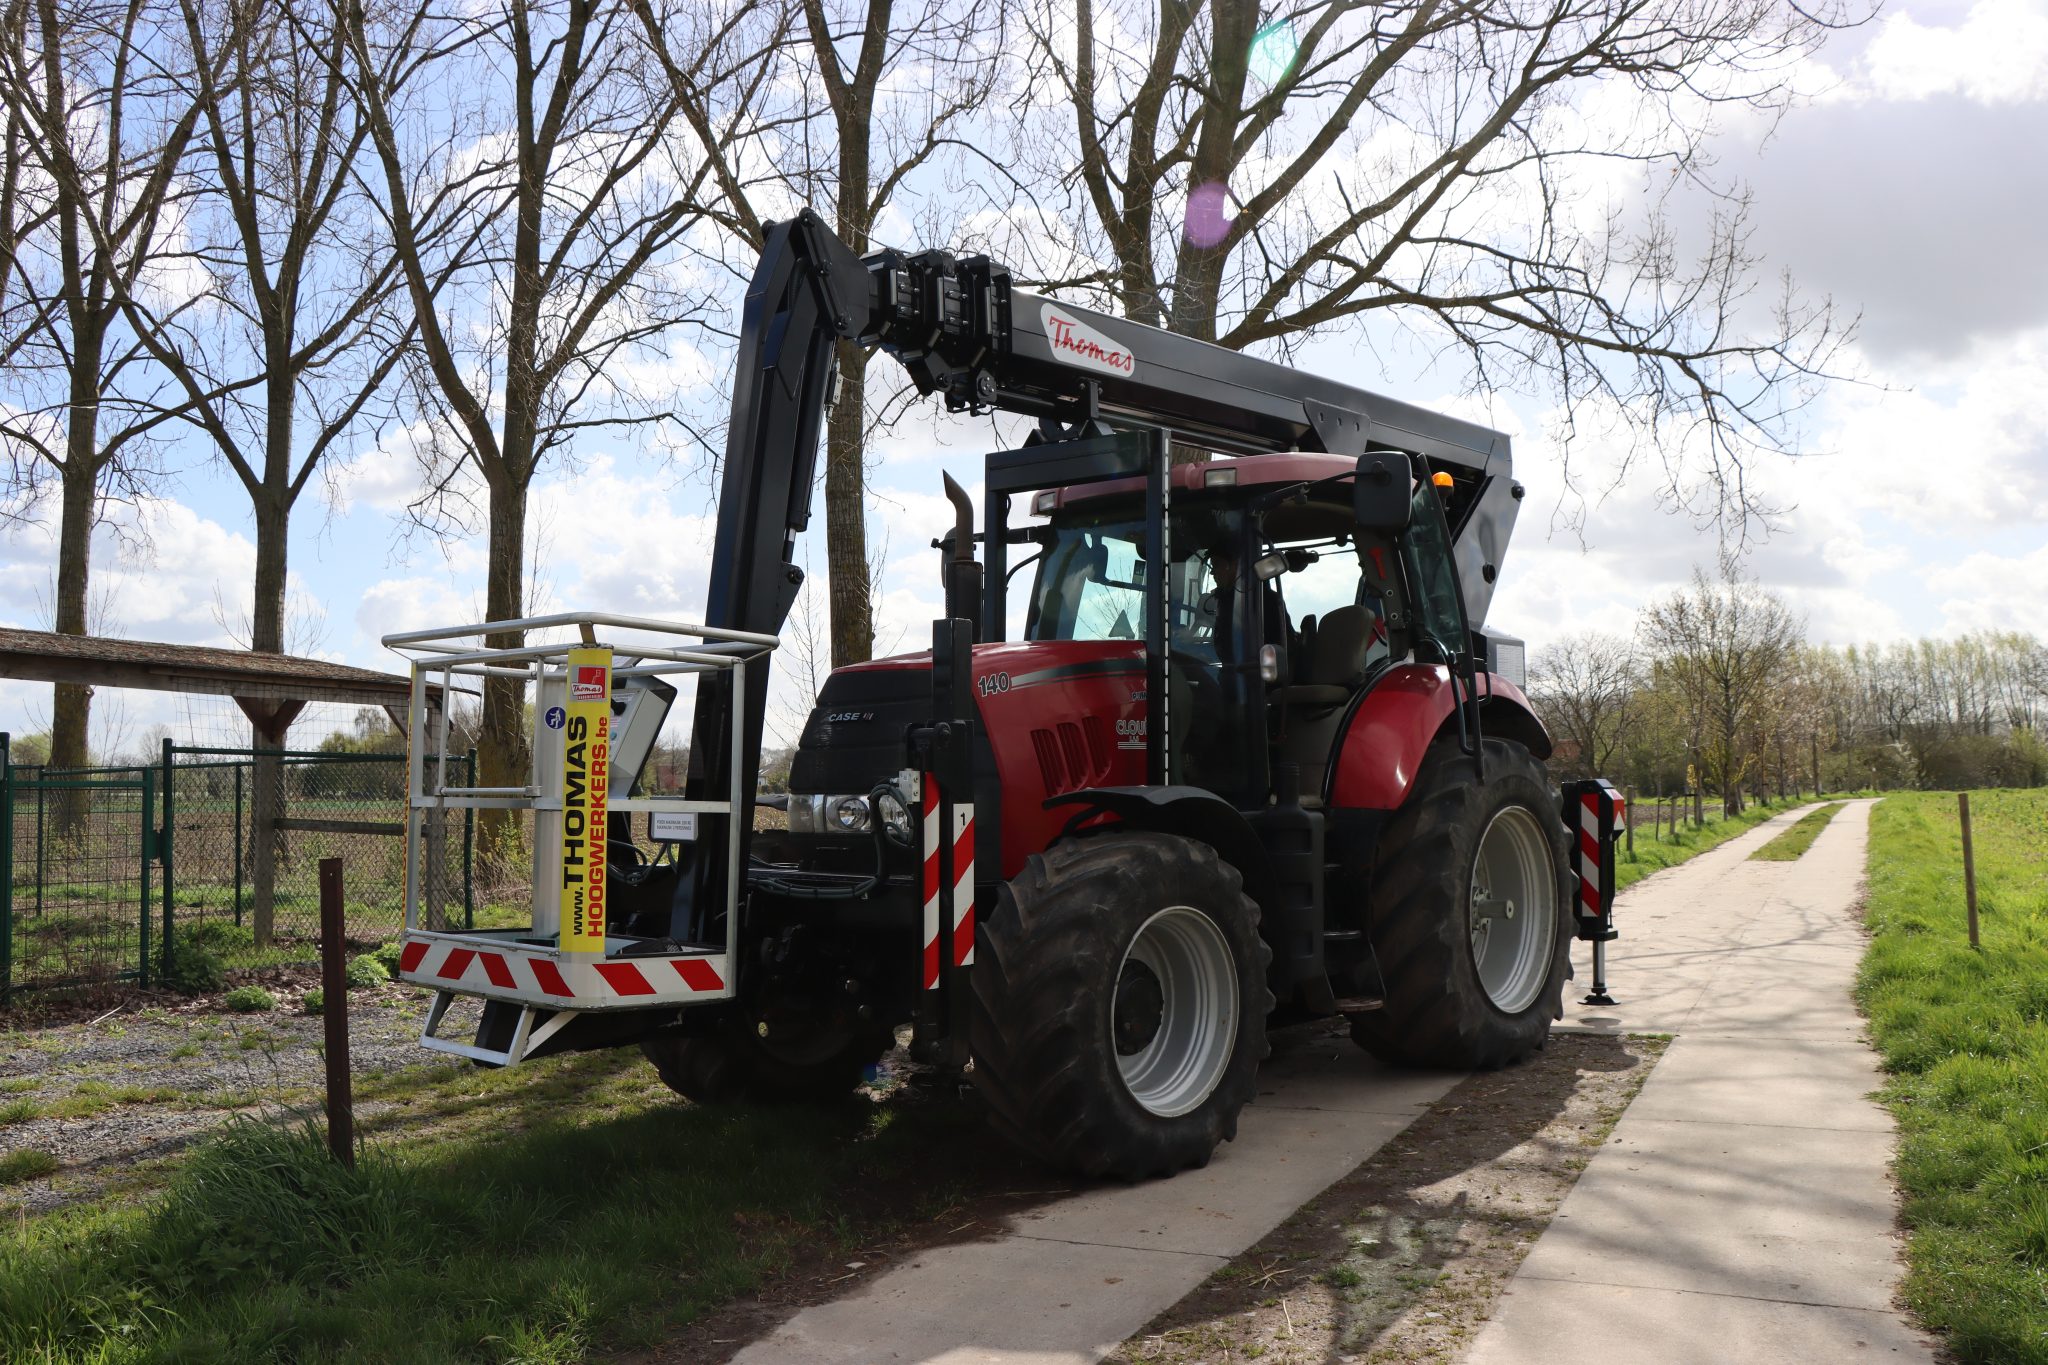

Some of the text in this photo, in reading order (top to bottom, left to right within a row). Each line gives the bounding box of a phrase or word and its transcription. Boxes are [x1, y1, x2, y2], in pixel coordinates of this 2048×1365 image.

[1049, 315, 1132, 371] Thomas
[978, 672, 1009, 697] 140
[828, 712, 861, 722] CASE
[1116, 717, 1147, 735] CLOU
[588, 716, 608, 937] HOOGWERKERS.be
[960, 811, 966, 826] 1
